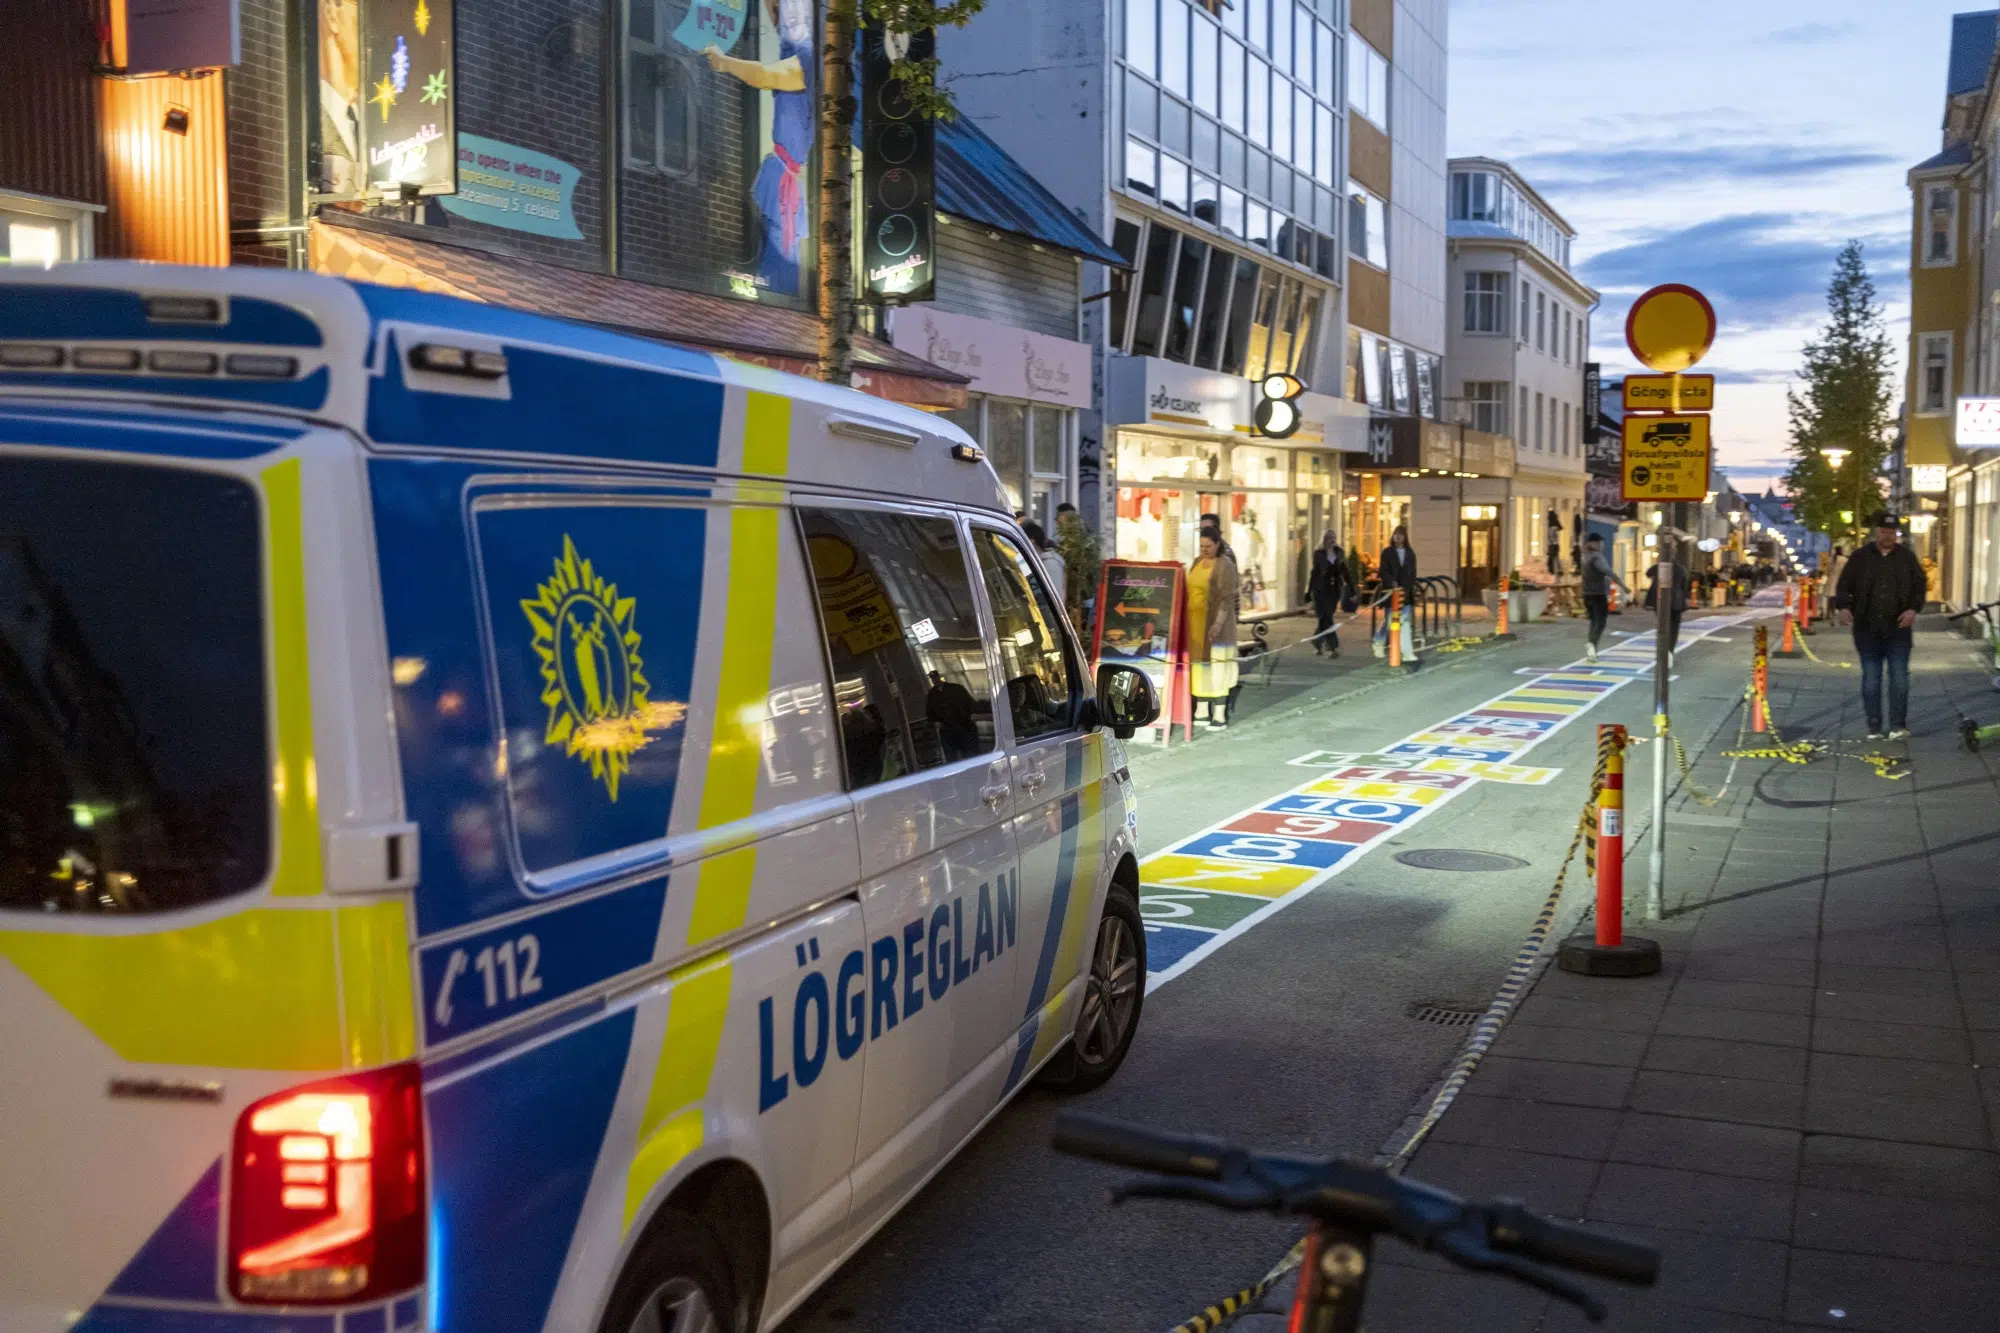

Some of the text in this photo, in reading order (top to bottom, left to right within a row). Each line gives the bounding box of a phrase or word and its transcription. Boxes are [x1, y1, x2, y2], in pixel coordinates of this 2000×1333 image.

[544, 169, 561, 184] the
[1630, 386, 1707, 399] Göngata
[1344, 769, 1456, 788] 12
[1279, 797, 1403, 819] 10
[1275, 816, 1341, 836] 9
[1210, 837, 1303, 861] 8
[1159, 860, 1281, 884] 7
[475, 934, 543, 1008] 112
[759, 867, 1017, 1114] LÖGREGLAN
